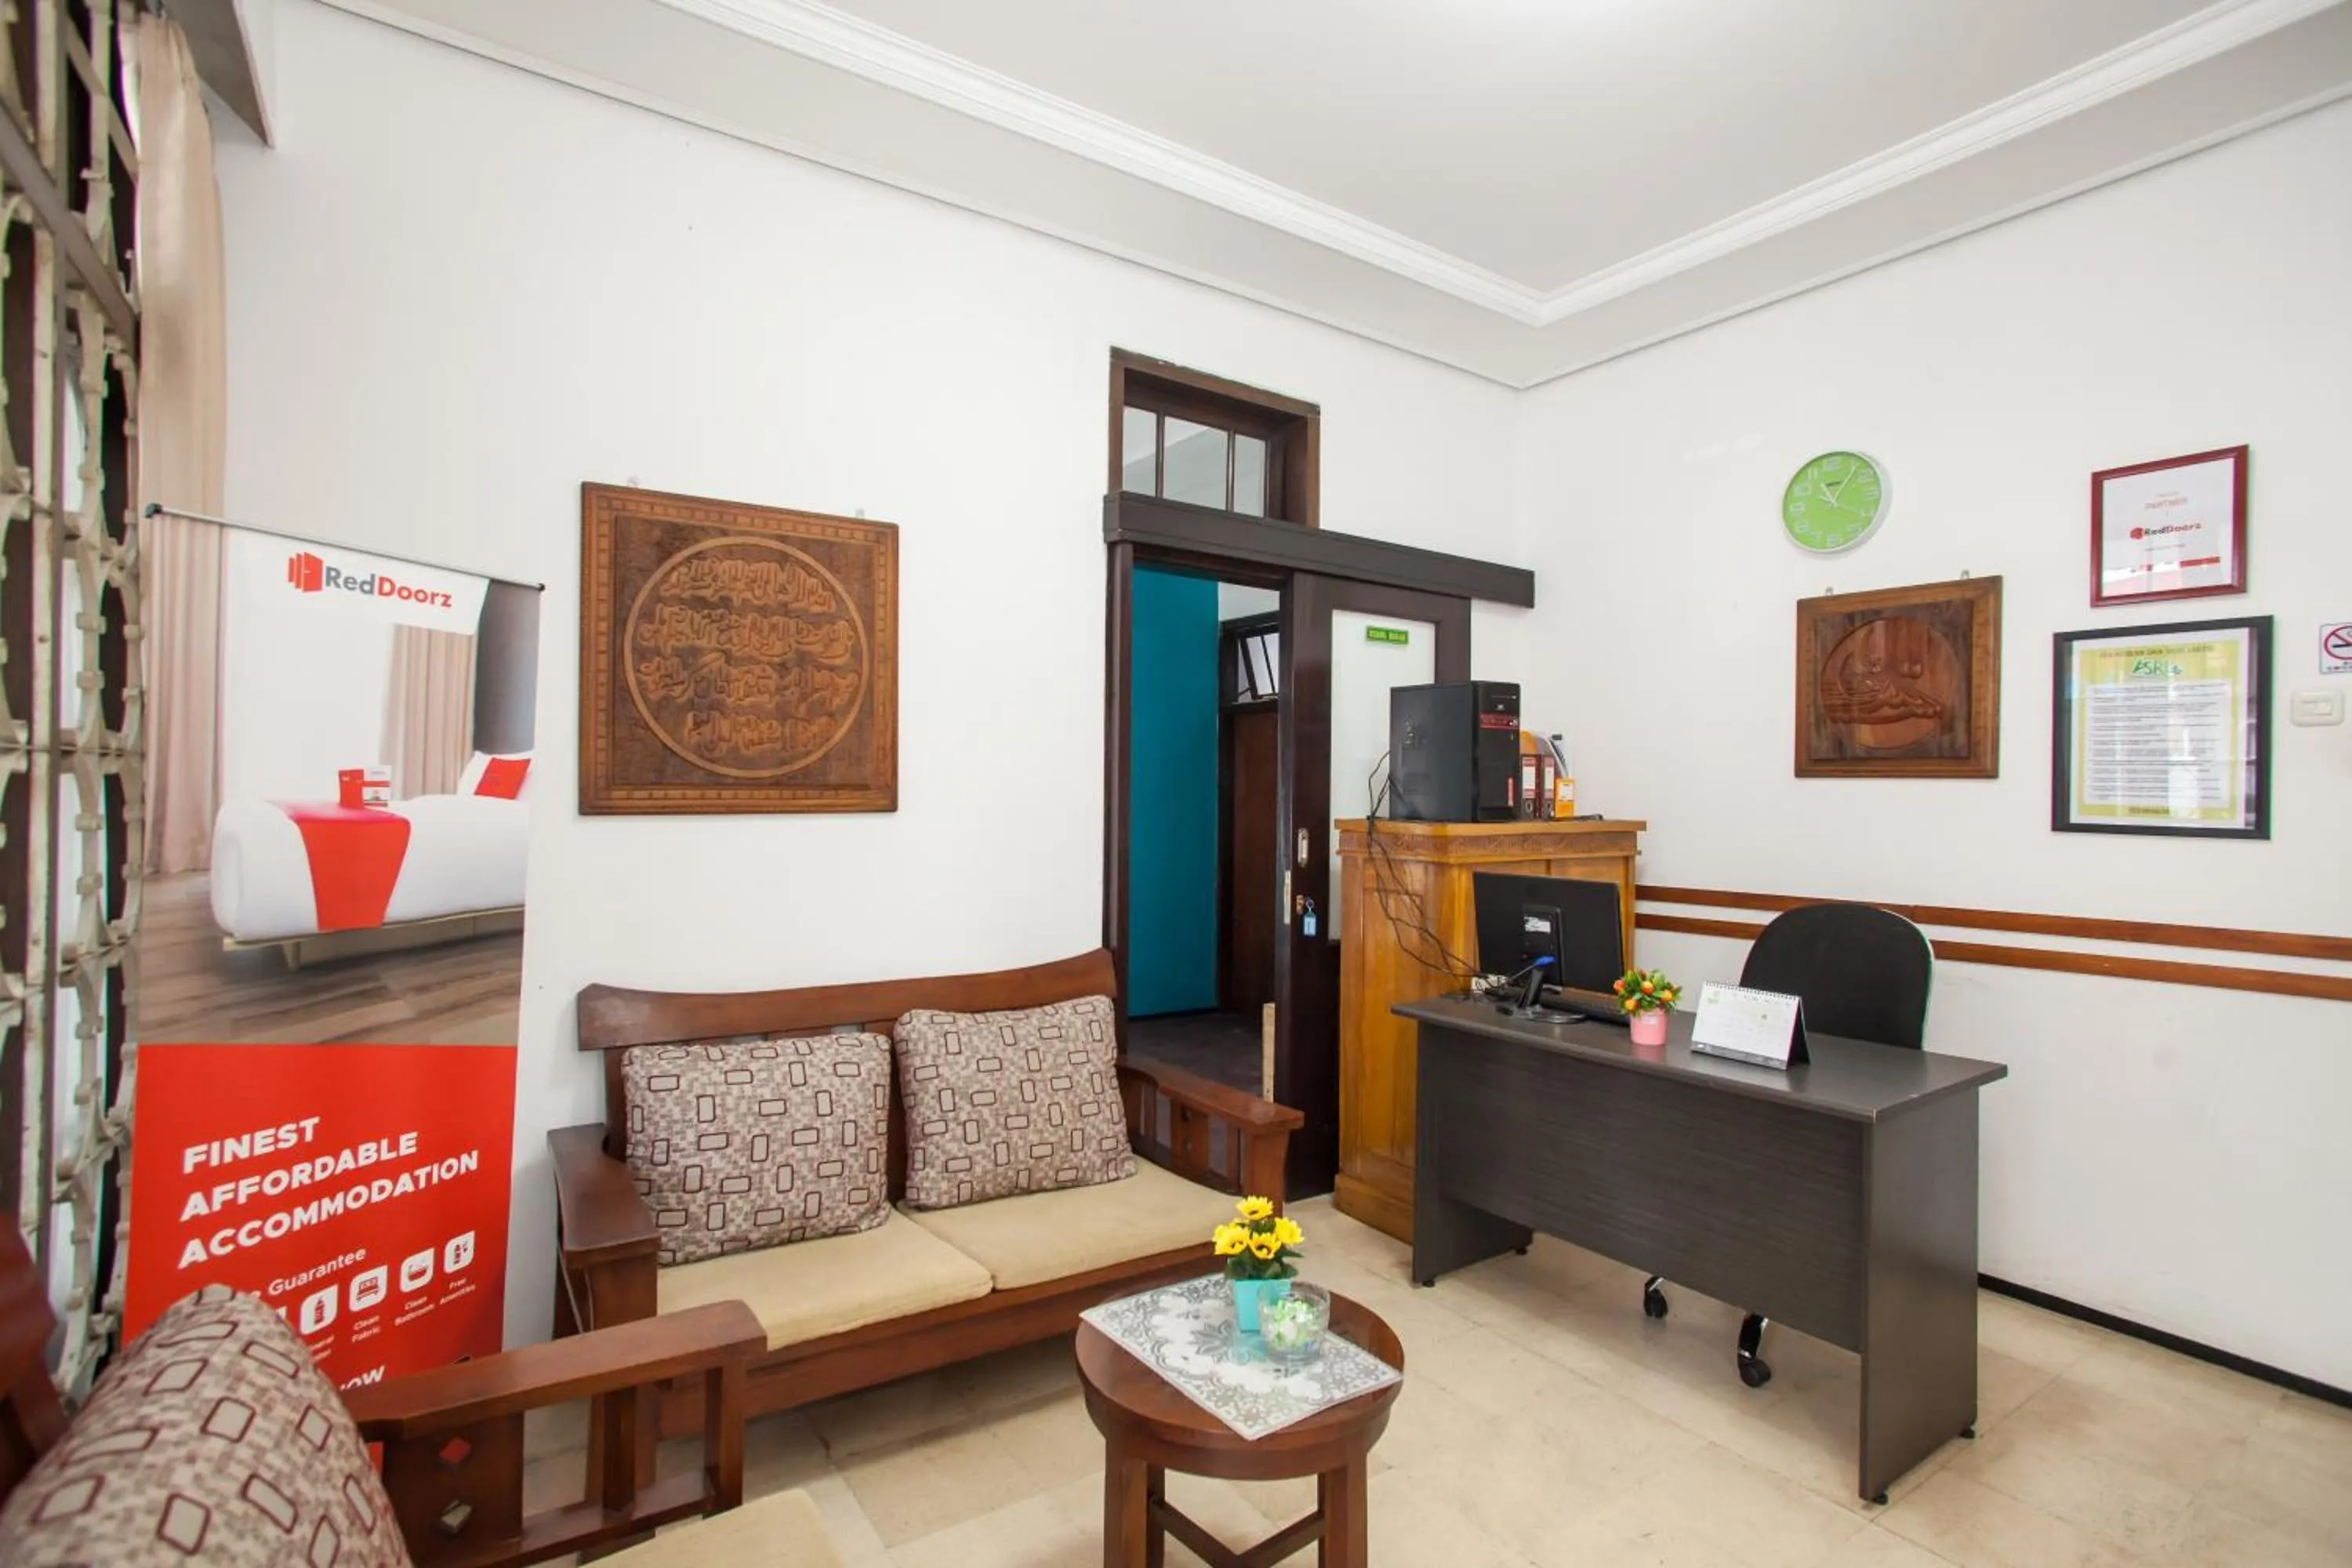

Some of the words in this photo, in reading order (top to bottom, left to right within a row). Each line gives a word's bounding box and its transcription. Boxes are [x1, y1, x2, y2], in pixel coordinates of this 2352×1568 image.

[325, 565, 453, 608] RedDoorz
[182, 1116, 321, 1174] FINEST
[180, 1131, 419, 1222] AFFORDABLE
[177, 1149, 480, 1269] ACCOMMODATION
[268, 1248, 367, 1296] Guarantee
